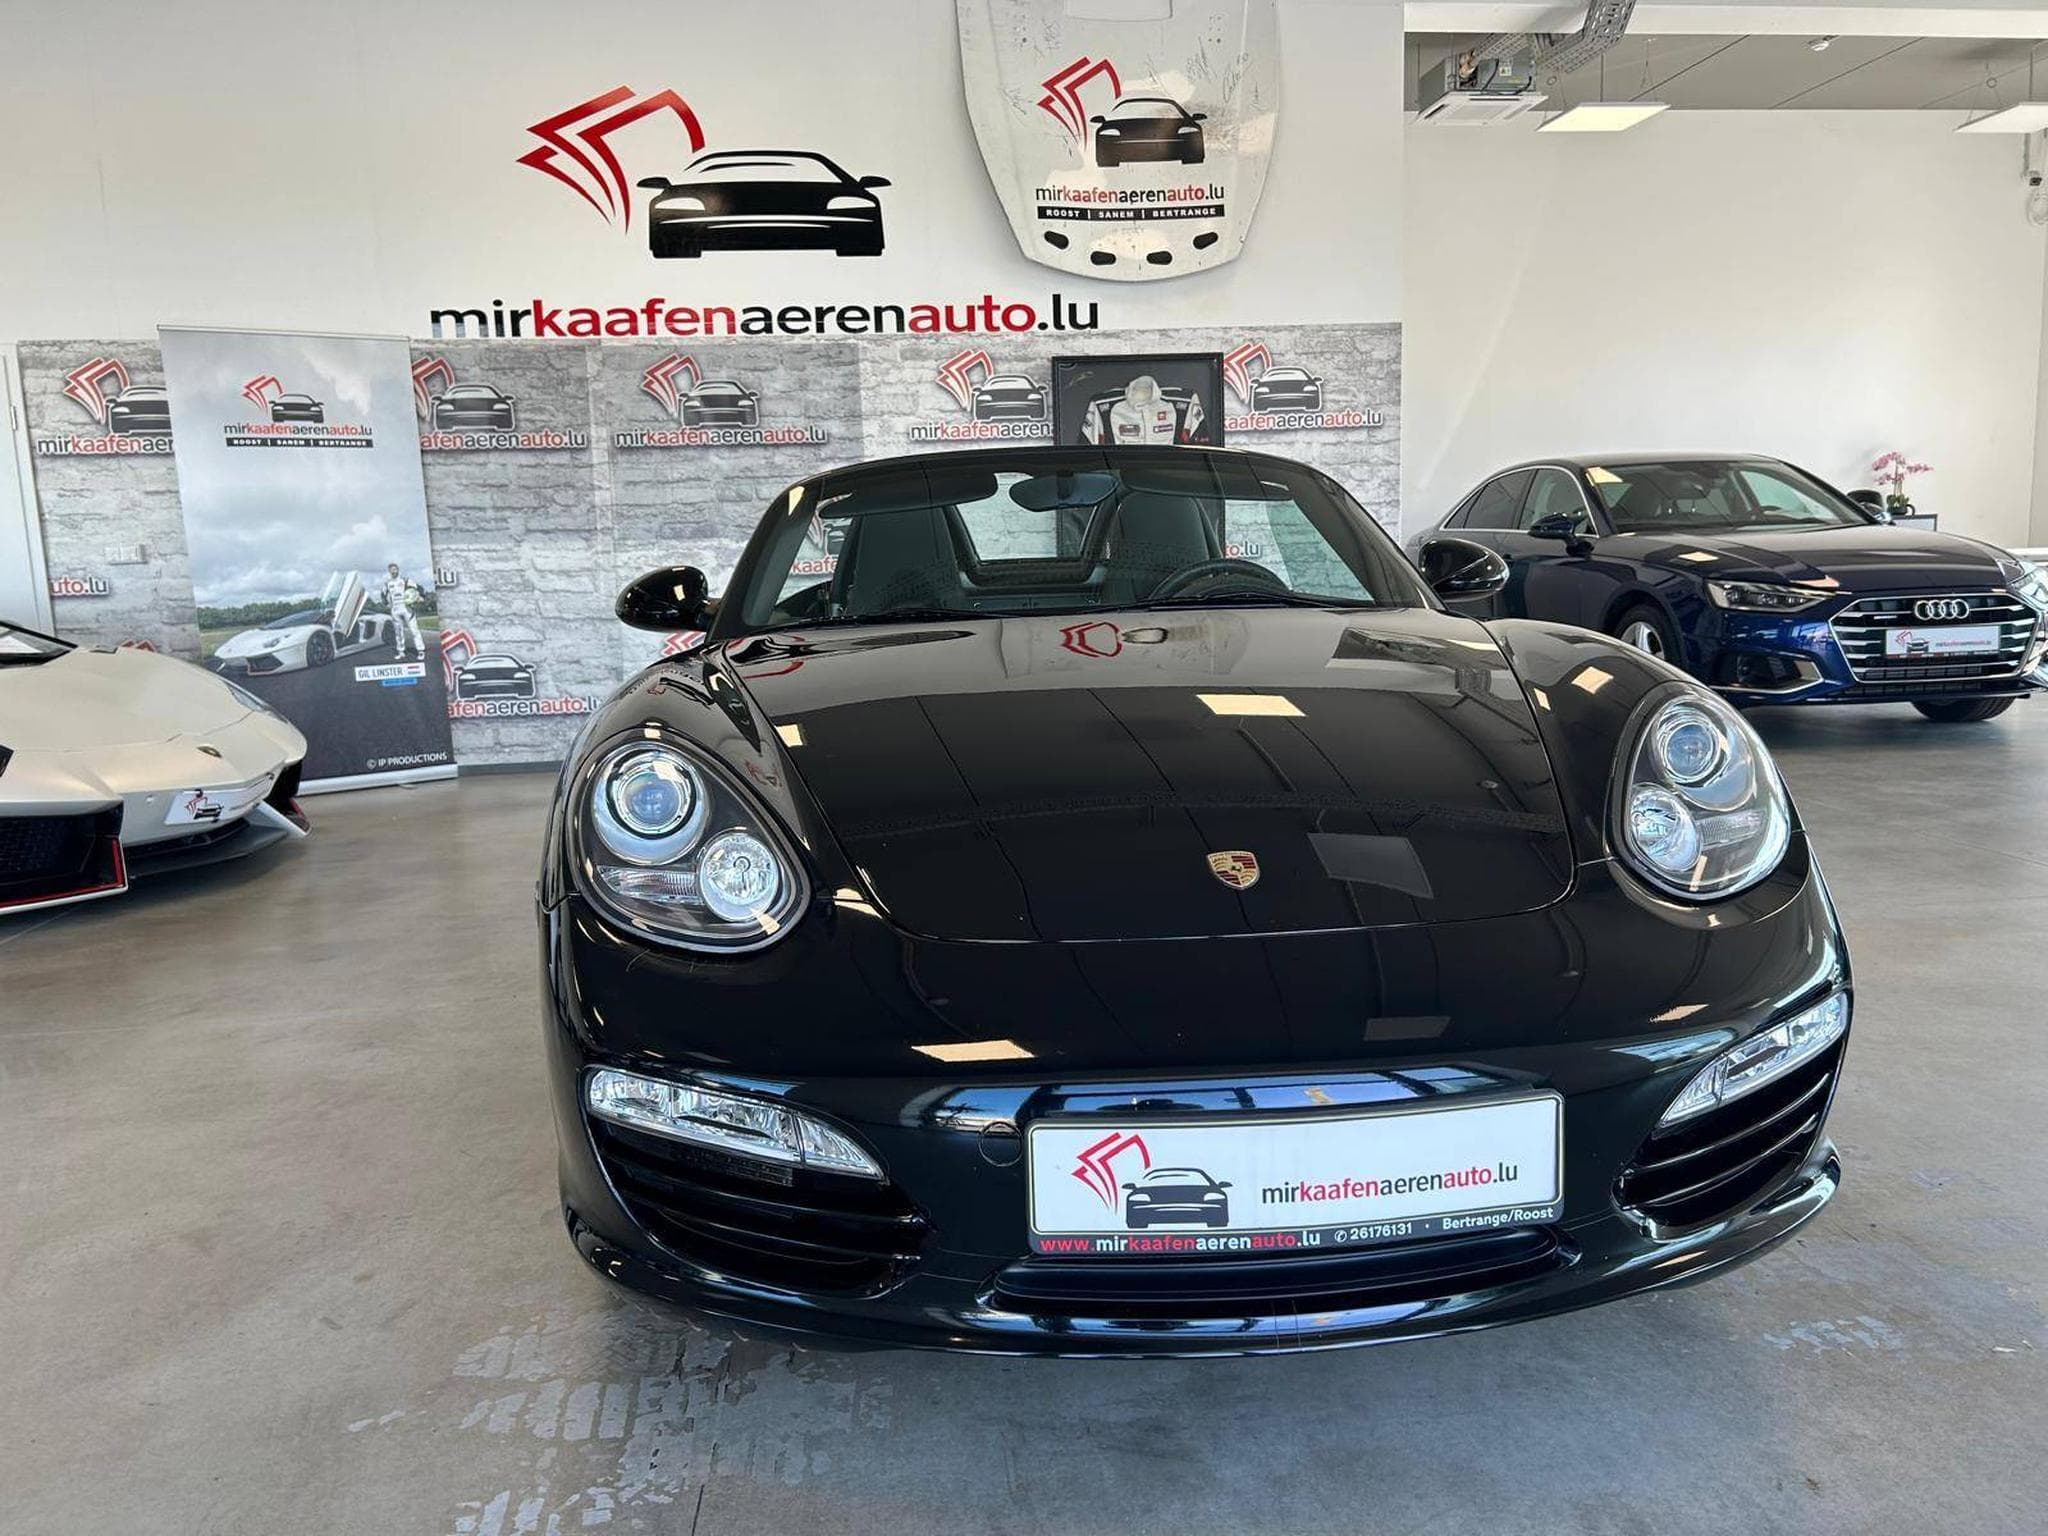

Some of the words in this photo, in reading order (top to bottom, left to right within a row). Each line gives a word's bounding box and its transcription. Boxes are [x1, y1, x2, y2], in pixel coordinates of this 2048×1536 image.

[1035, 183, 1225, 203] mirkaafenaerenauto.lu
[1046, 208, 1081, 217] ROOST
[1098, 210, 1134, 219] SANEM
[1152, 207, 1217, 218] BERTRANGE
[431, 294, 1099, 338] mirkaafenaerenauto.lu
[224, 422, 373, 436] mirkaafenaerenauto.lu
[616, 425, 827, 447] mirkaafenaerenauto.lu
[911, 422, 1051, 439] mirkaafenaeren
[38, 435, 173, 453] mirkaafenaer
[420, 430, 586, 448] afenaerenauto.lu
[372, 666, 404, 678] LINSTER
[387, 751, 448, 766] PRODUCTIONS
[1261, 1162, 1519, 1204] mirkaafenaerenauto.lu
[1040, 1230, 1321, 1253] www.mirkaafenaerenauto.lu
[1350, 1222, 1413, 1241] 26176131
[1442, 1206, 1555, 1231] Bertrange/Roost
